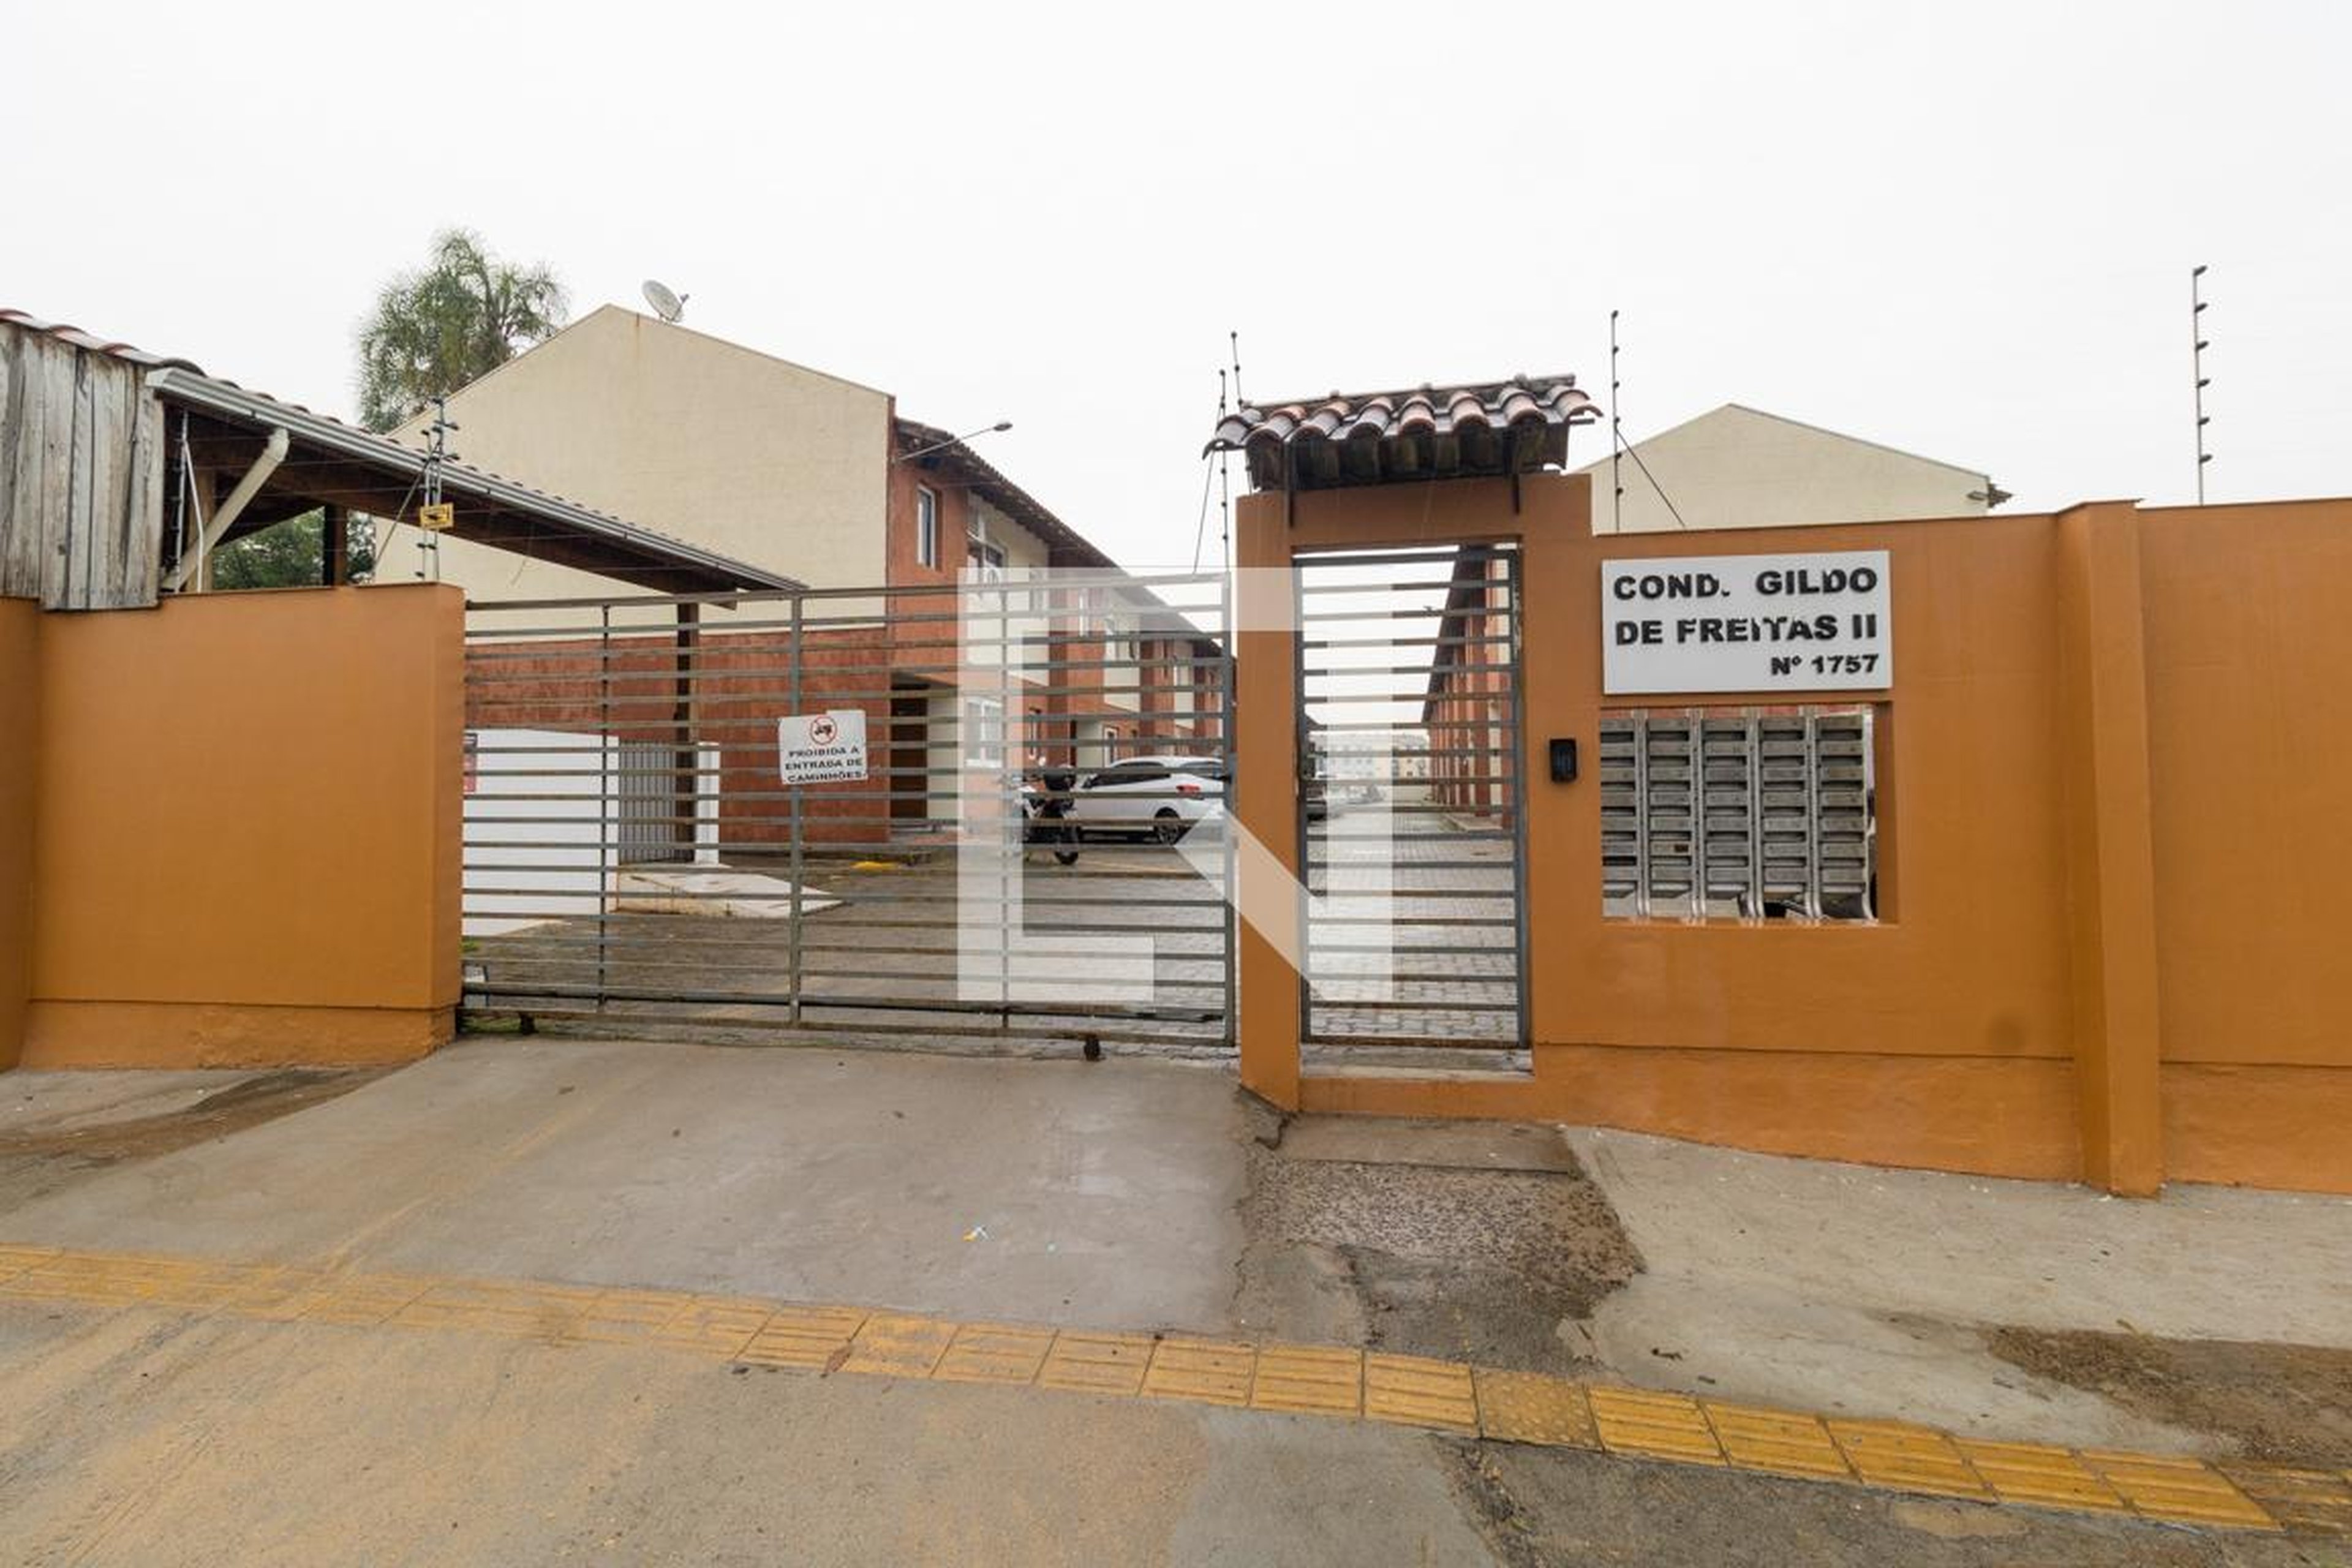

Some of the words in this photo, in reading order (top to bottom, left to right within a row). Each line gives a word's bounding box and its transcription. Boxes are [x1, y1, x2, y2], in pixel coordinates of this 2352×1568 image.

[1613, 573, 1730, 600] COND.
[1755, 567, 1877, 595] GILDO
[1615, 620, 1663, 645] DE
[1676, 614, 1838, 643] FREITAS
[1852, 614, 1877, 639] II
[1811, 654, 1879, 674] 1757
[789, 747, 846, 758] PROIBIDA
[785, 760, 843, 770] ENTRADA
[846, 758, 862, 766] DE
